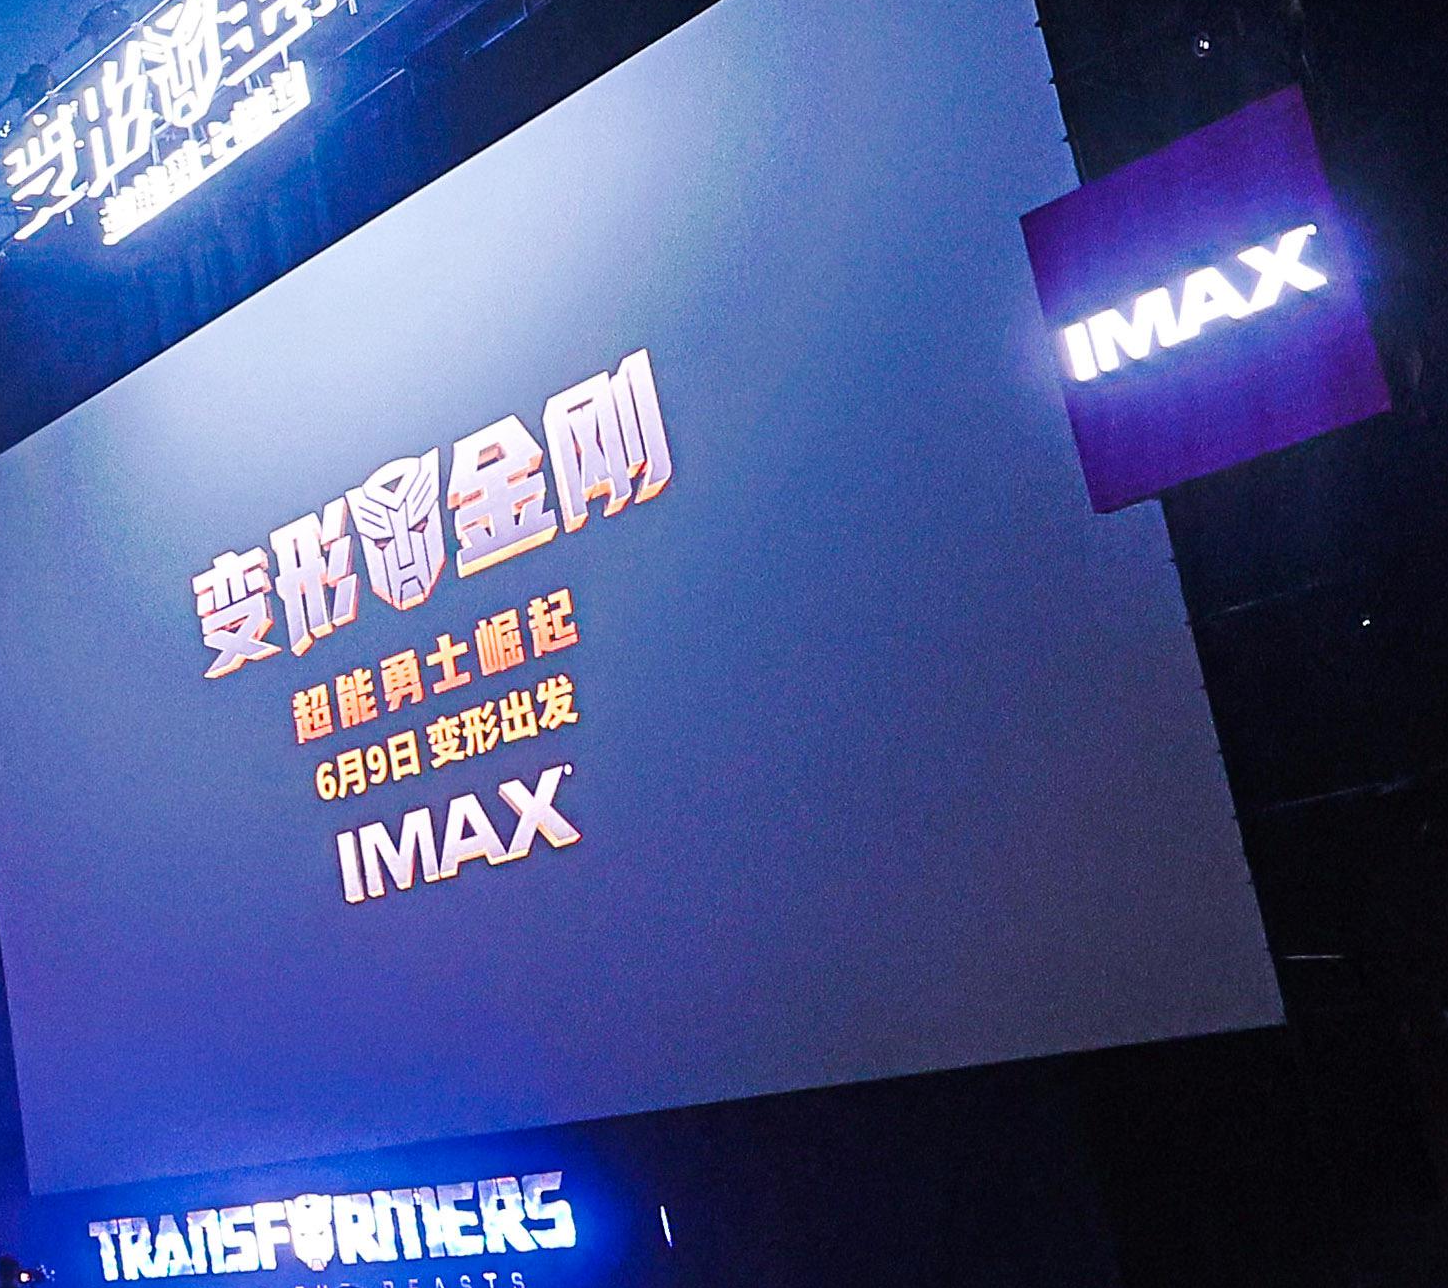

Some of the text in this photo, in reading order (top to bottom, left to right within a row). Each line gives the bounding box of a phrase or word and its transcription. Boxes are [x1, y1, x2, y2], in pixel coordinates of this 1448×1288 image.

[1063, 224, 1329, 382] IMAX
[191, 348, 673, 679] 变形金刚
[292, 588, 579, 744] 超能勇士崛起
[315, 675, 580, 802] 6月9日 变形出发
[335, 764, 582, 904] IMAX
